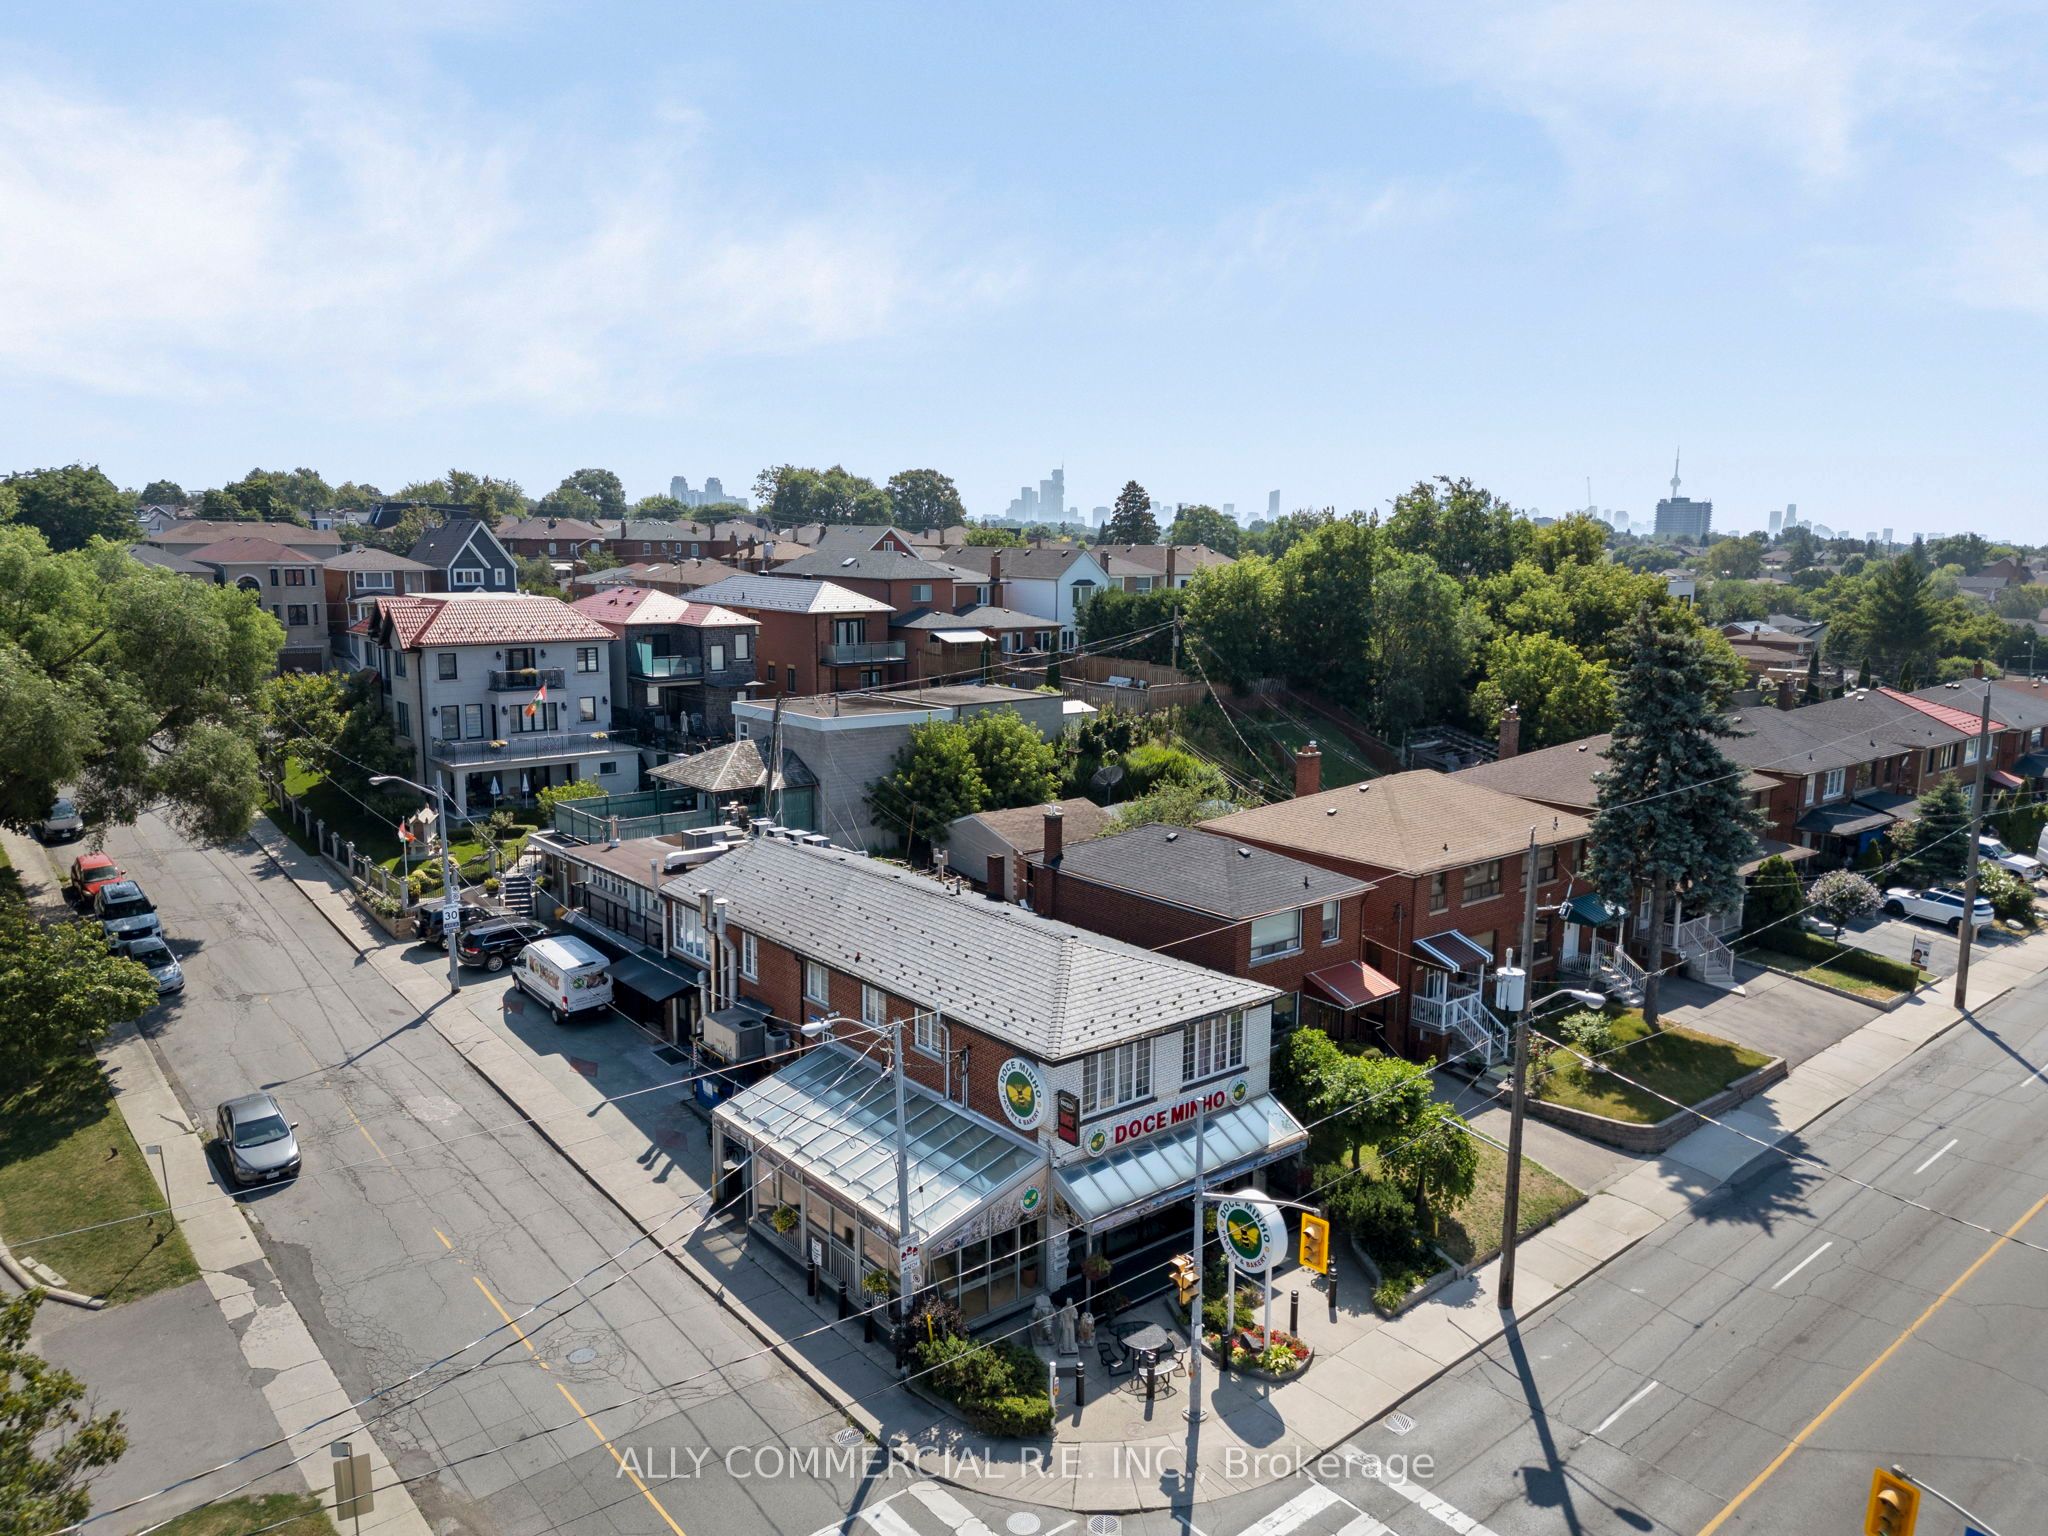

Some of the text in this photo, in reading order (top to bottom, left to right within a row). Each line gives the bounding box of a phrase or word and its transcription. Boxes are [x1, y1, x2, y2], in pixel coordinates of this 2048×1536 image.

[445, 911, 458, 920] 30
[1000, 1061, 1042, 1098] DOCE MINHO
[1002, 1095, 1018, 1121] PASTRY
[1023, 1110, 1040, 1125] BAKERY
[1115, 1110, 1167, 1144] DOCE
[1244, 1202, 1270, 1243] MINHO
[1222, 1230, 1239, 1259] PASTRY
[1246, 1253, 1266, 1268] BAKERY
